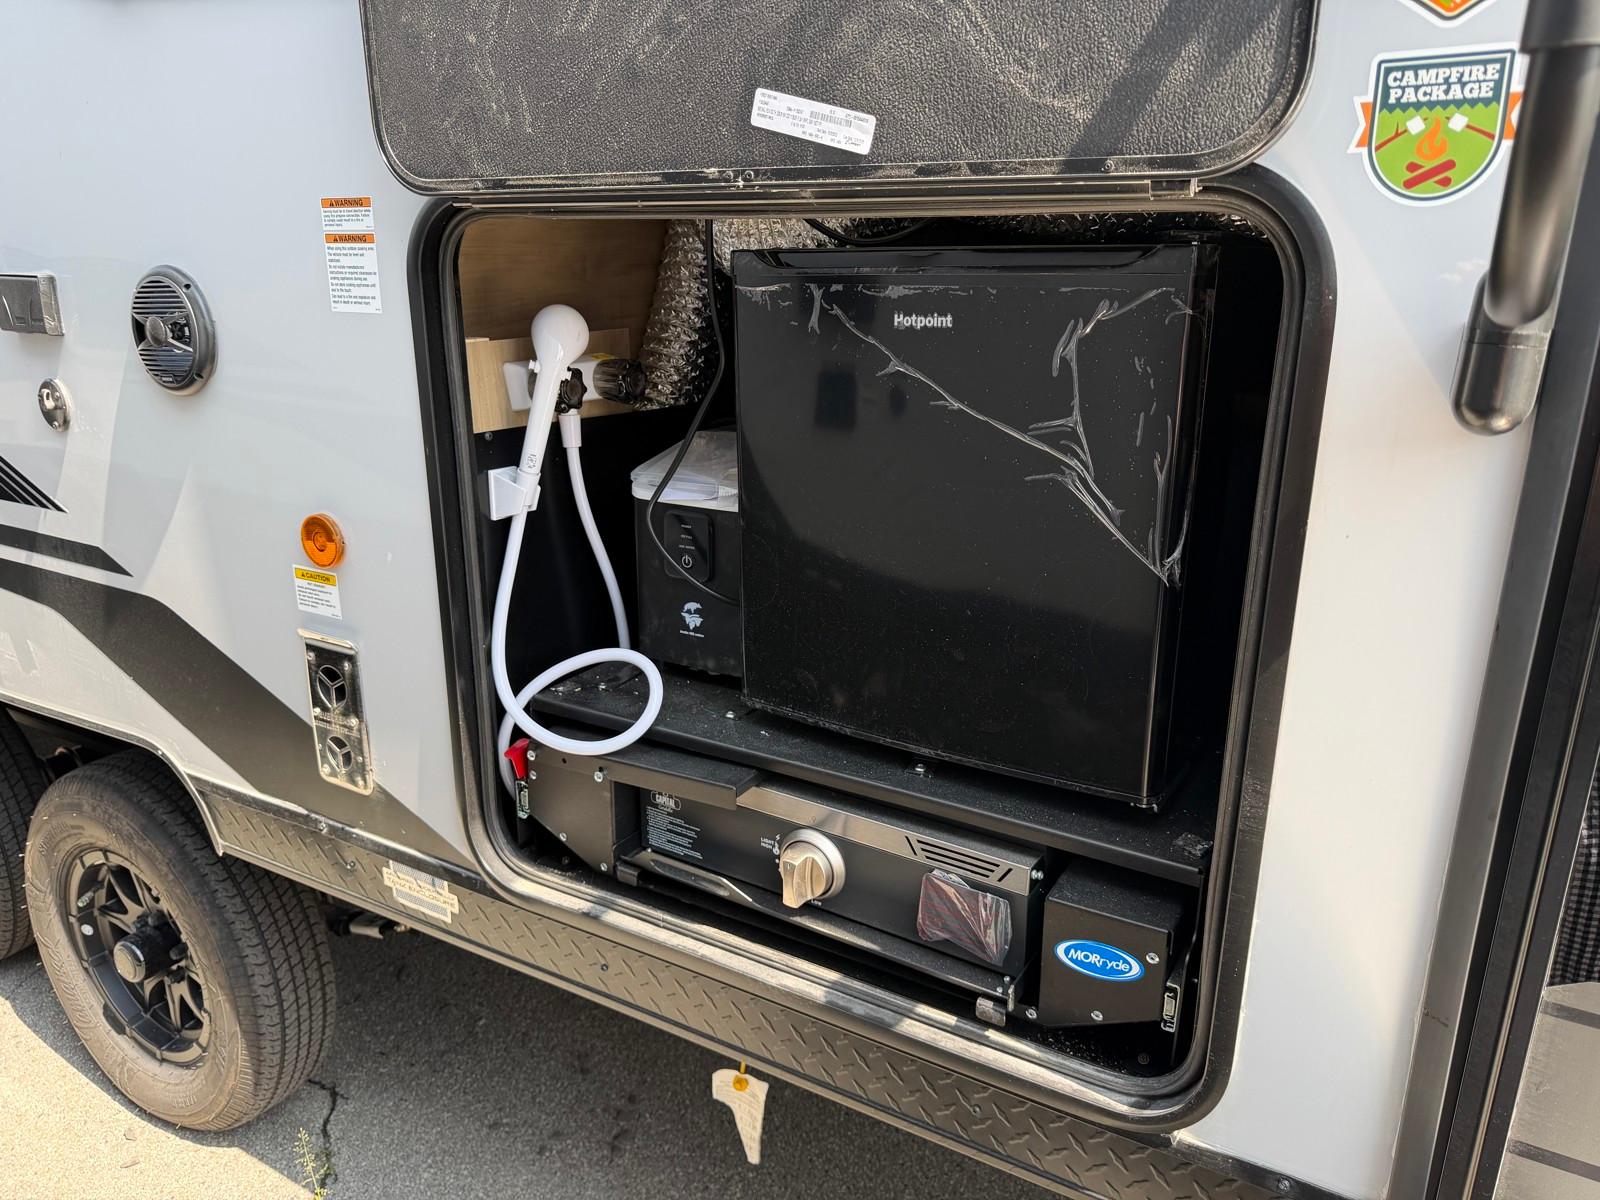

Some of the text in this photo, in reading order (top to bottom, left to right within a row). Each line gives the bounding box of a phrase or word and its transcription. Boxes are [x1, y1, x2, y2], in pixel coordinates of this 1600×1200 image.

[1387, 63, 1501, 87] CAMPFIRE
[1388, 81, 1496, 104] PACKAGE
[334, 199, 363, 207] WARNING
[894, 313, 953, 330] Hotpoint
[306, 572, 331, 582] CAUTION
[1068, 948, 1130, 972] MORryde
